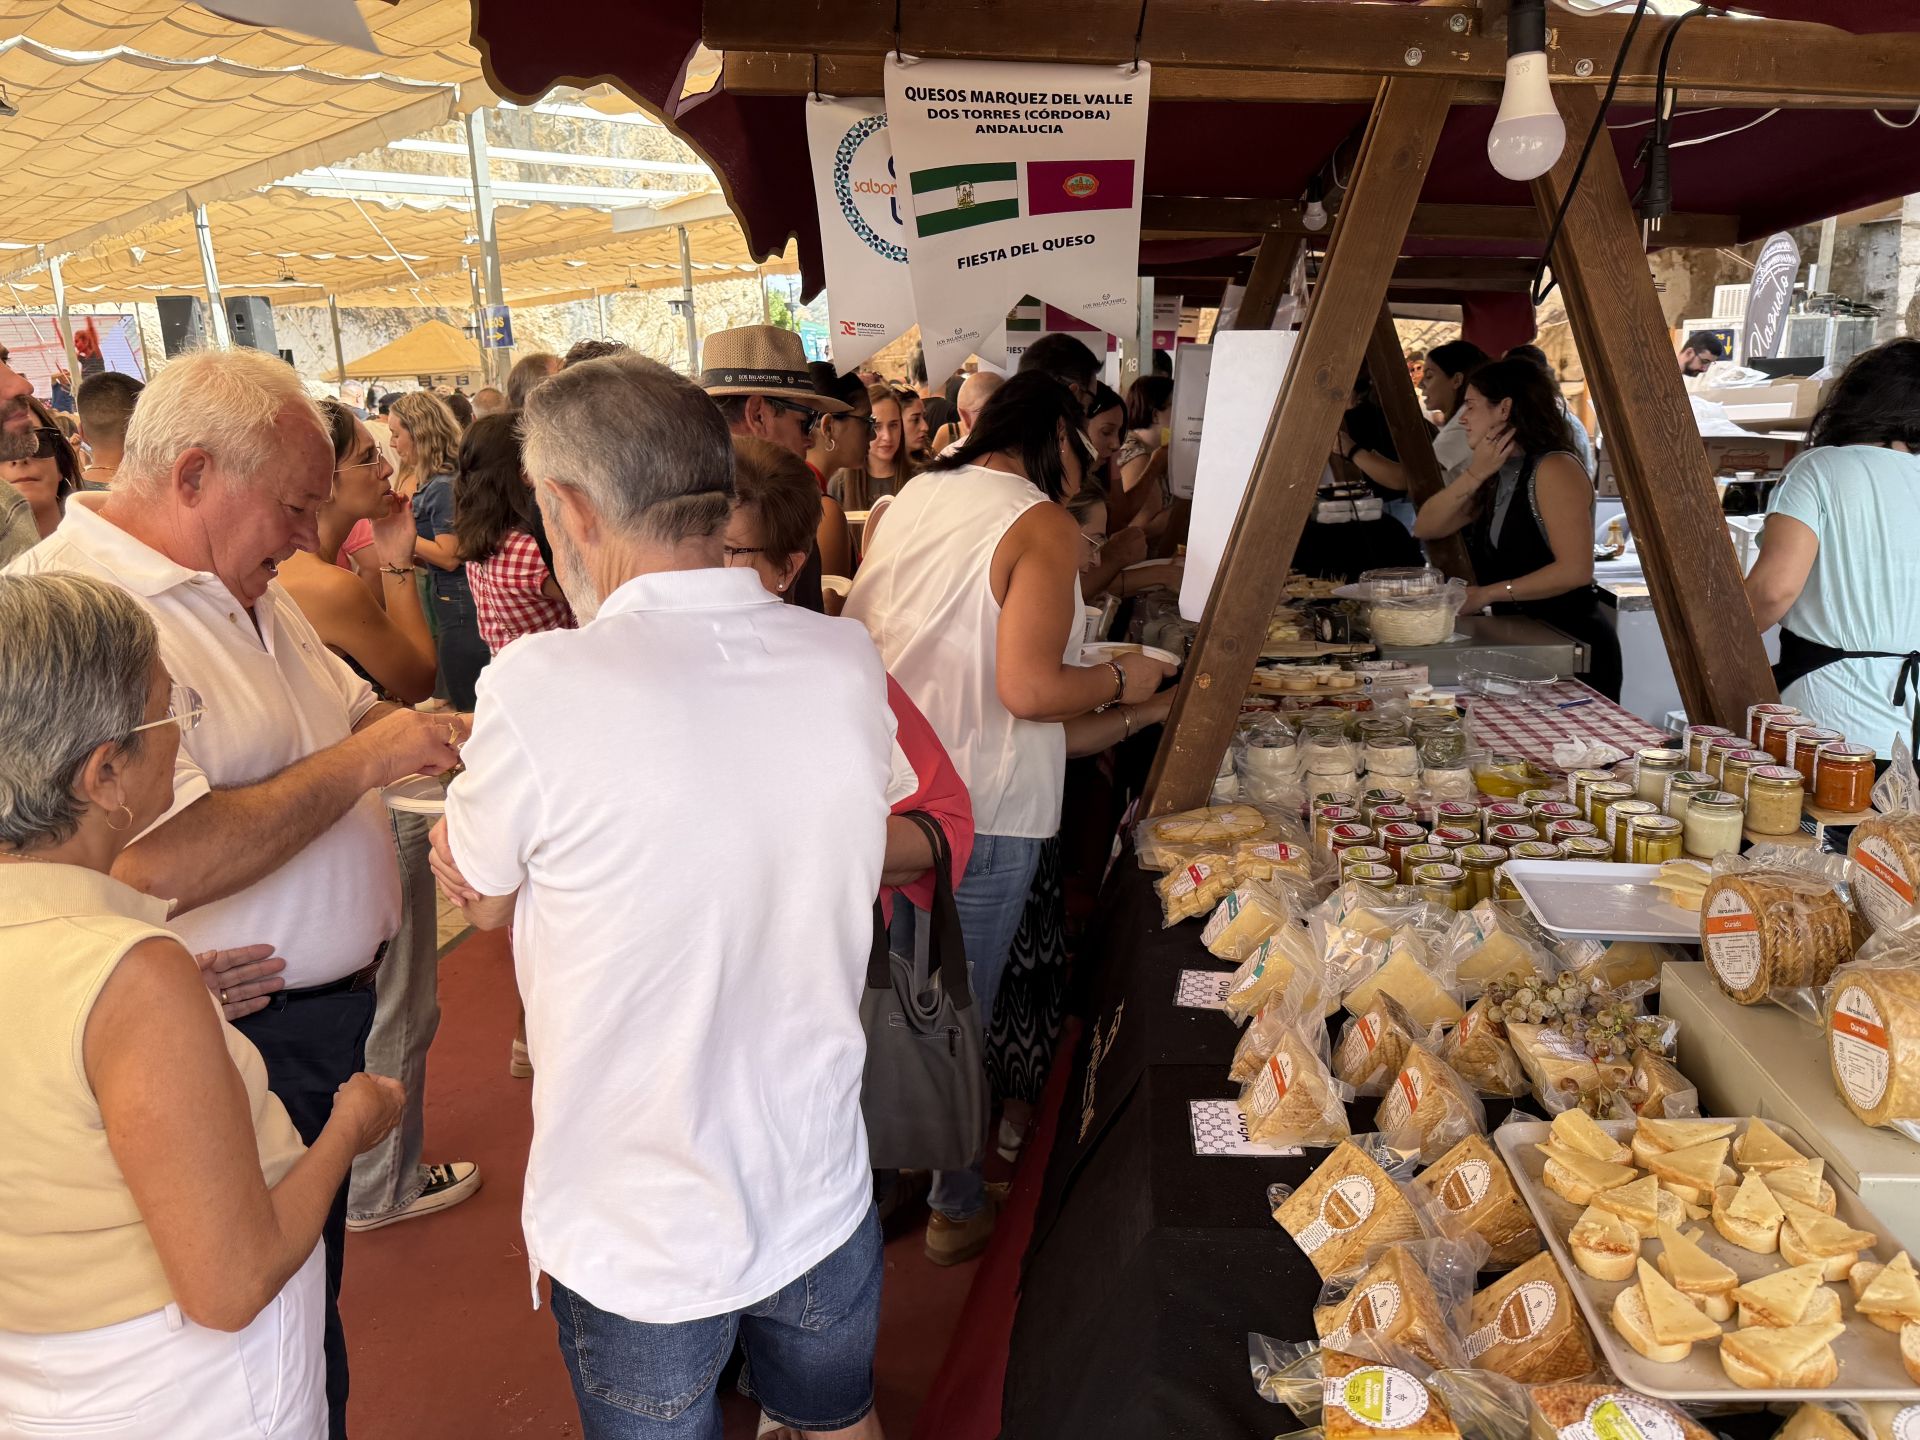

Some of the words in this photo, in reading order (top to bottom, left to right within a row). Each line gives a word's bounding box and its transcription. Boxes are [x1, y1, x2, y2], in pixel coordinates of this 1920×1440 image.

[904, 86, 967, 102] QUESOS
[970, 90, 1048, 105] MARQUEZ
[1051, 93, 1081, 105] DEL
[1084, 93, 1133, 105] VALLE
[927, 108, 959, 120] DOS
[962, 109, 1021, 120] TORRES
[1024, 107, 1111, 121] (CÓRDOBA)
[975, 124, 1064, 134] ANDALUCIA
[957, 249, 1007, 270] FIESTA
[1010, 242, 1039, 257] DEL
[1042, 234, 1096, 251] QUESO
